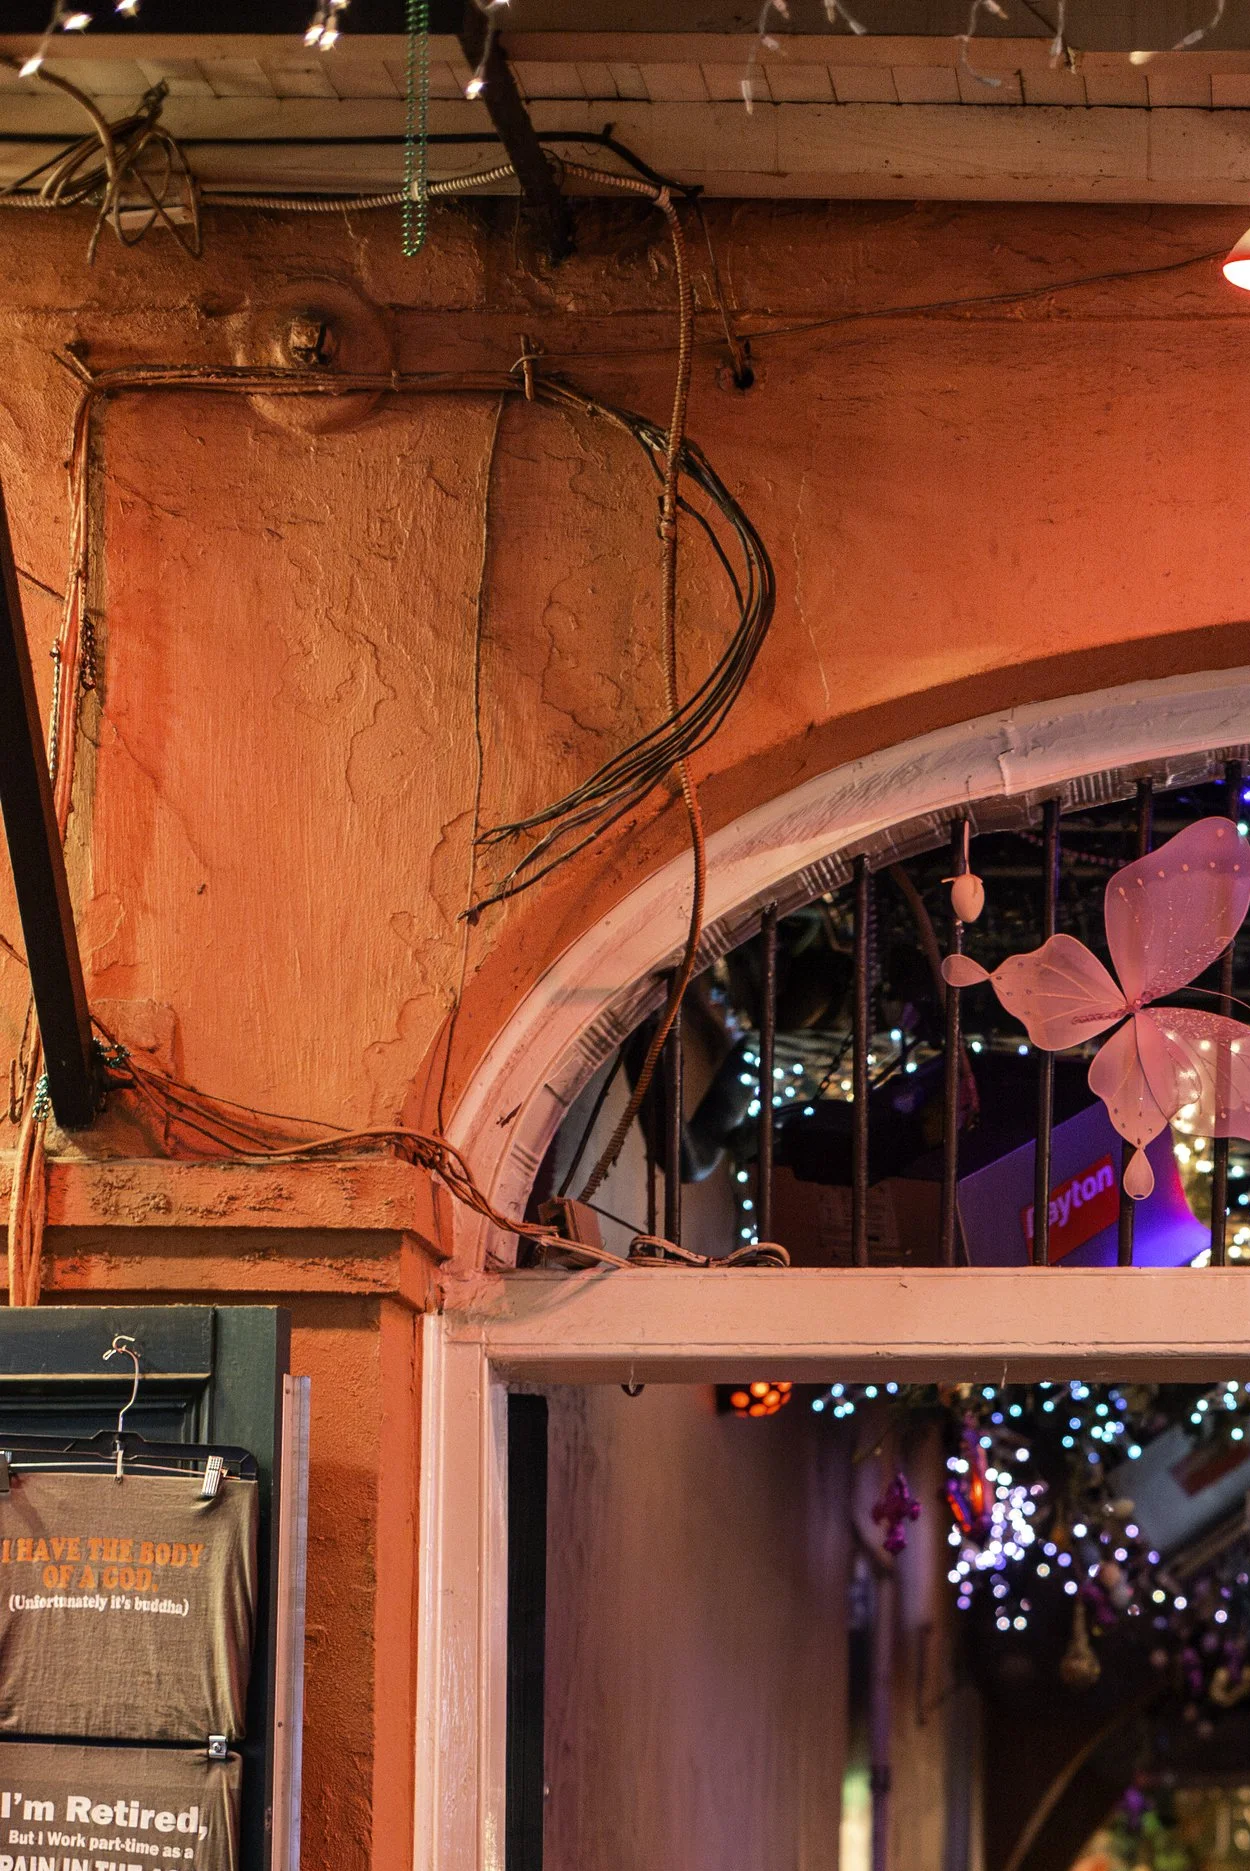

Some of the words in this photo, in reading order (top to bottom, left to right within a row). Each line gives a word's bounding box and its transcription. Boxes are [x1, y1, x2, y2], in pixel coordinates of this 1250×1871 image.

[1026, 1165, 1114, 1239] ayton
[1, 1539, 11, 1564] I
[17, 1537, 81, 1562] HAVE
[87, 1537, 134, 1562] THE
[140, 1541, 206, 1568] BODY
[43, 1565, 75, 1590] OF
[79, 1566, 96, 1590] A
[103, 1567, 159, 1592] GOD.
[9, 1594, 108, 1612] (Unfortunately
[110, 1595, 131, 1610] it's
[134, 1598, 190, 1616] buddha)
[1, 1792, 55, 1821] I'm
[66, 1795, 209, 1841] Retired,
[9, 1830, 34, 1845] But
[38, 1831, 43, 1845] I
[47, 1831, 86, 1847] Work
[89, 1837, 160, 1857] part-time
[162, 1845, 181, 1858] as
[183, 1847, 194, 1859] a
